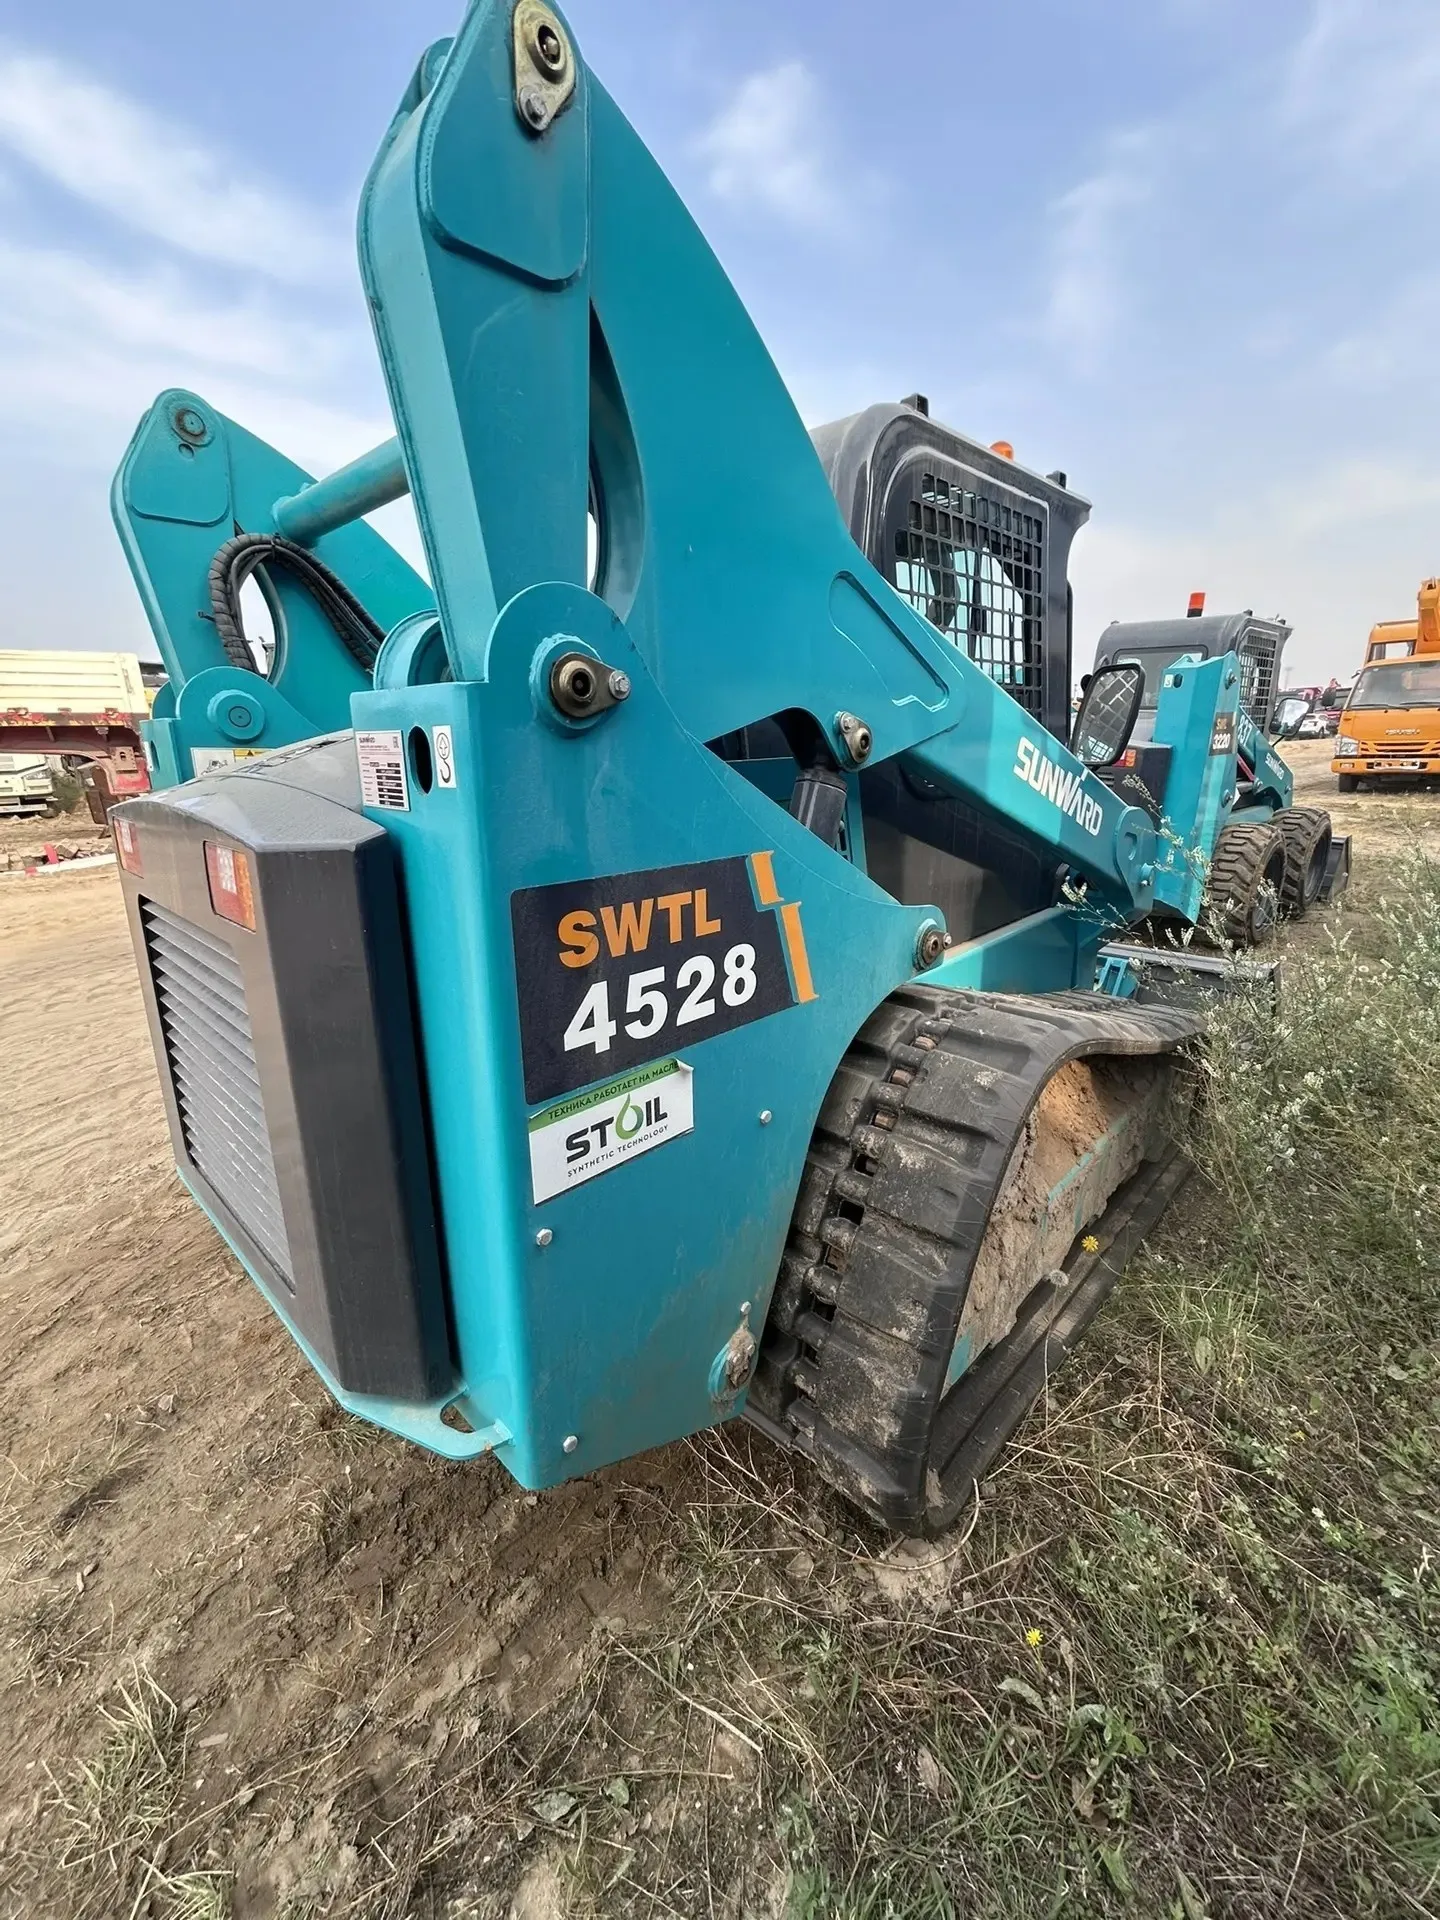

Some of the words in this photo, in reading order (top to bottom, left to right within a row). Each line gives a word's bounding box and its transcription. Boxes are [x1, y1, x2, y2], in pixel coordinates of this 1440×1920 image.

[1013, 736, 1103, 836] SUNWARD
[557, 888, 721, 968] SWTL
[563, 943, 758, 1054] 4528
[548, 1097, 593, 1120] ТЕХНИКА
[593, 1078, 638, 1102] РАБОТАЕТ
[639, 1073, 651, 1084] НА
[565, 1093, 668, 1164] STOIL
[567, 1150, 614, 1178] SYNTHETIC
[617, 1124, 669, 1153] TECHNOLOGY
